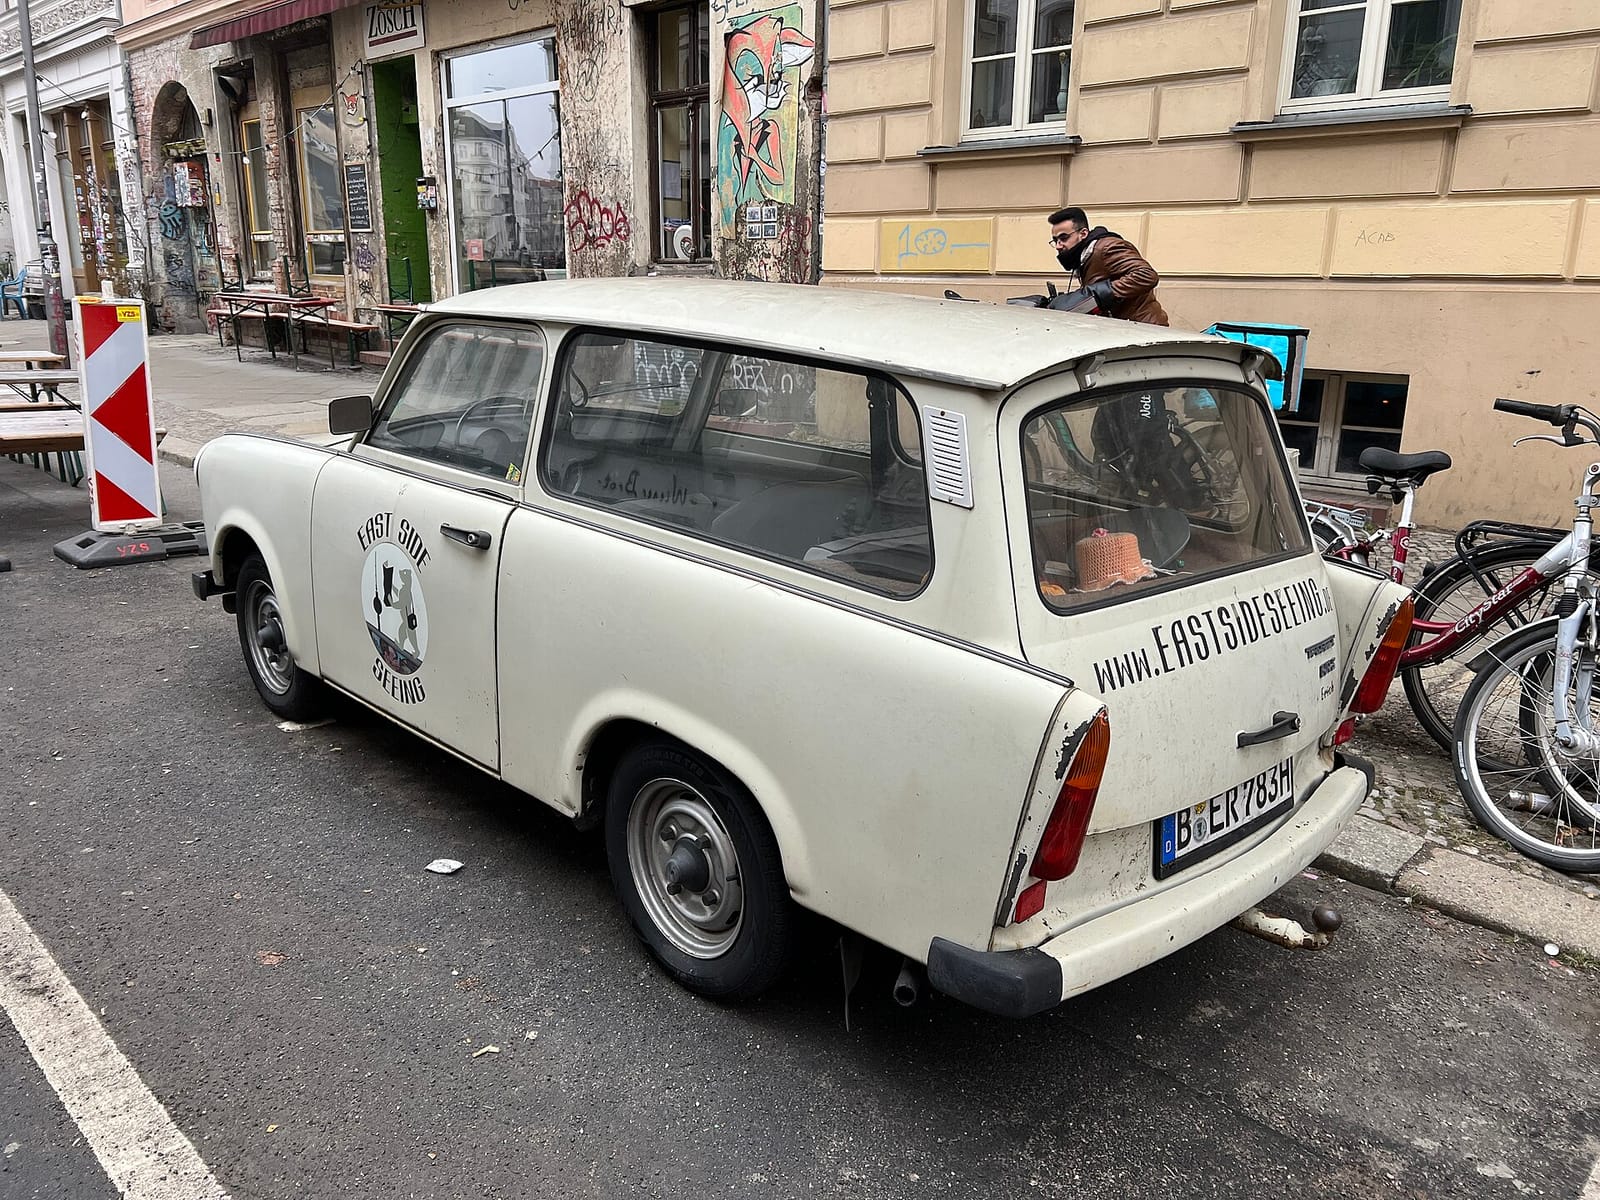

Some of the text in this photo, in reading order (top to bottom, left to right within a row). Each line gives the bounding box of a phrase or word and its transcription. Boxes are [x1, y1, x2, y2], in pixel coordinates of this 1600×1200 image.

[357, 512, 432, 574] EAST SIDE
[372, 657, 426, 705] SEEING
[1165, 840, 1172, 853] D
